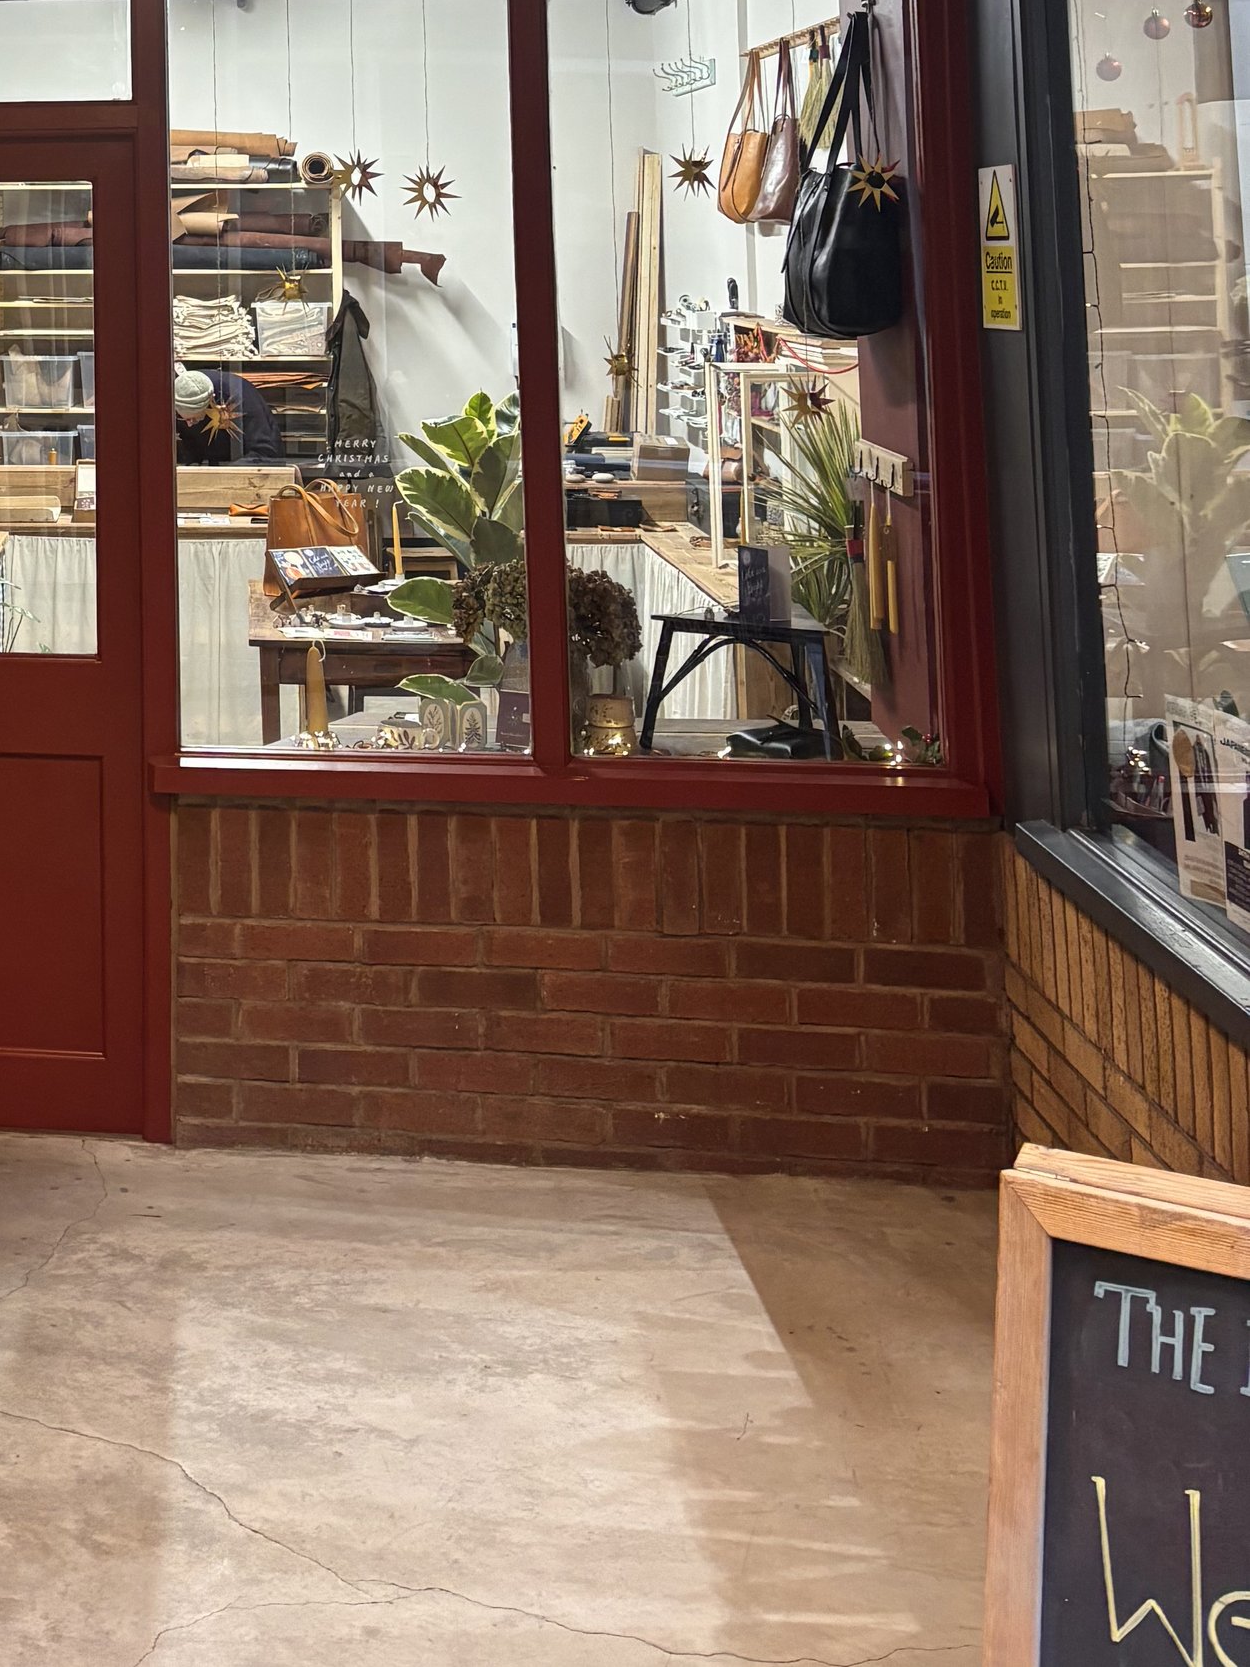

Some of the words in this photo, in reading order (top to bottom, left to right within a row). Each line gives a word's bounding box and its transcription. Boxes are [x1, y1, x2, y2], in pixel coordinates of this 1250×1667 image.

[985, 251, 1013, 270] Caution
[334, 438, 377, 449] MERRY
[317, 454, 390, 464] CHRISTMAS
[367, 484, 394, 493] NEW
[1093, 1280, 1215, 1395] THE
